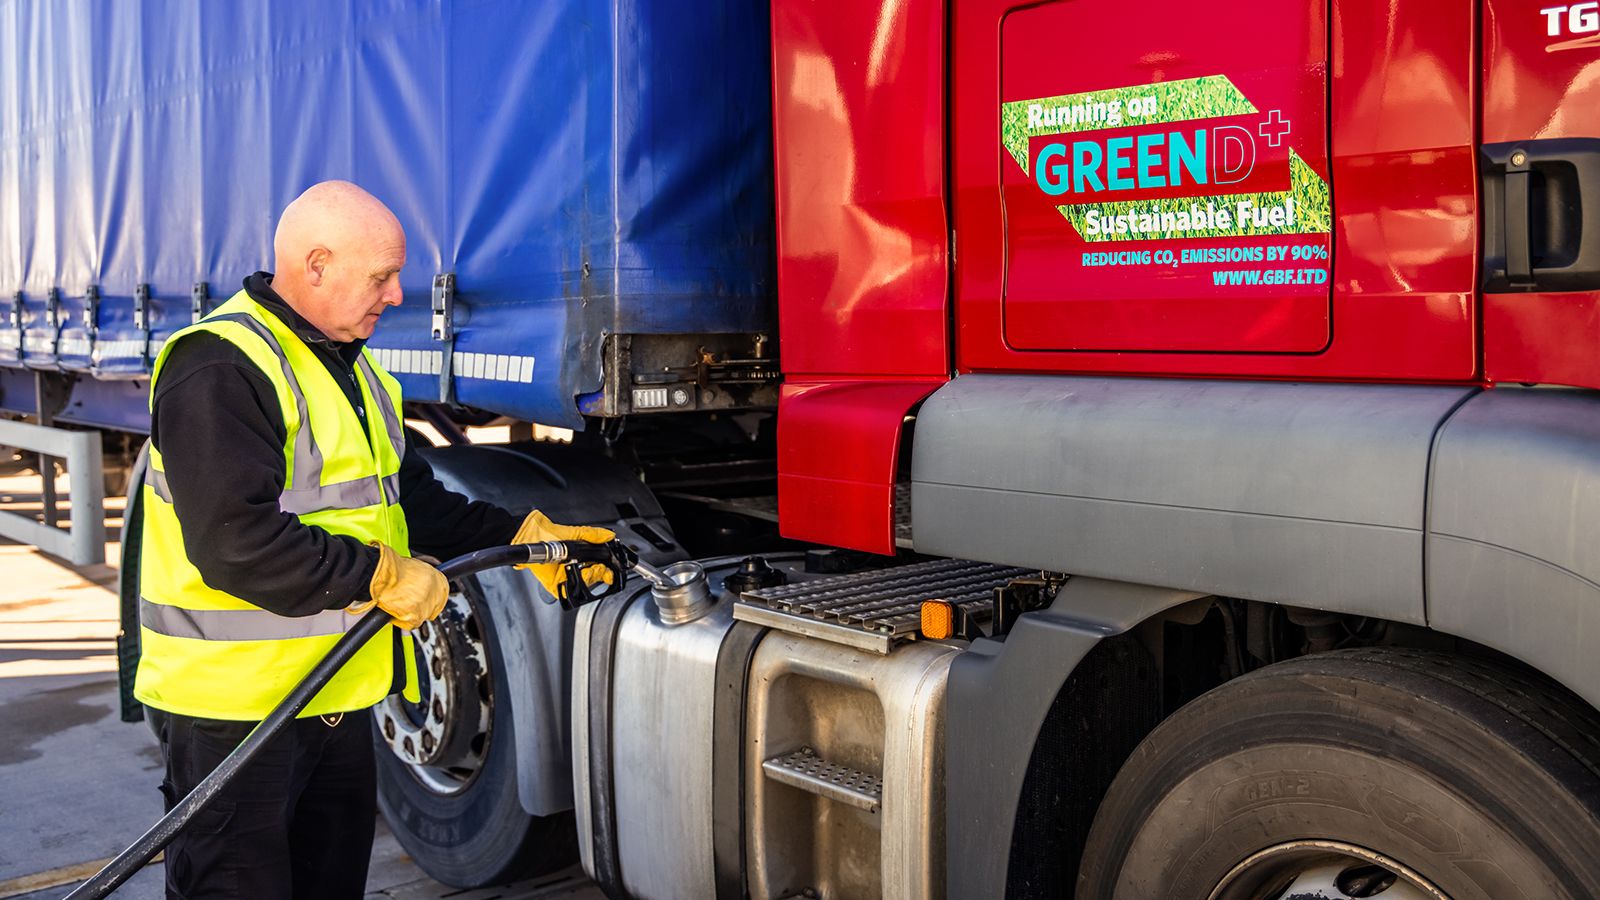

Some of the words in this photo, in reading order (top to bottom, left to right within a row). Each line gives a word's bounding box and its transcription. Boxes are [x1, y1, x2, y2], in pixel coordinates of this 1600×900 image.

[1540, 1, 1600, 36] TG
[1027, 97, 1121, 129] Running
[1127, 95, 1157, 118] on
[1085, 202, 1232, 235] Sustainable
[1236, 198, 1294, 228] Fuel
[1081, 250, 1151, 267] REDUCING
[1181, 247, 1264, 264] EMISSIONS
[1266, 246, 1289, 261] BY
[1290, 245, 1328, 260] 90%
[1212, 269, 1328, 286] WWW.GBF.LTD
